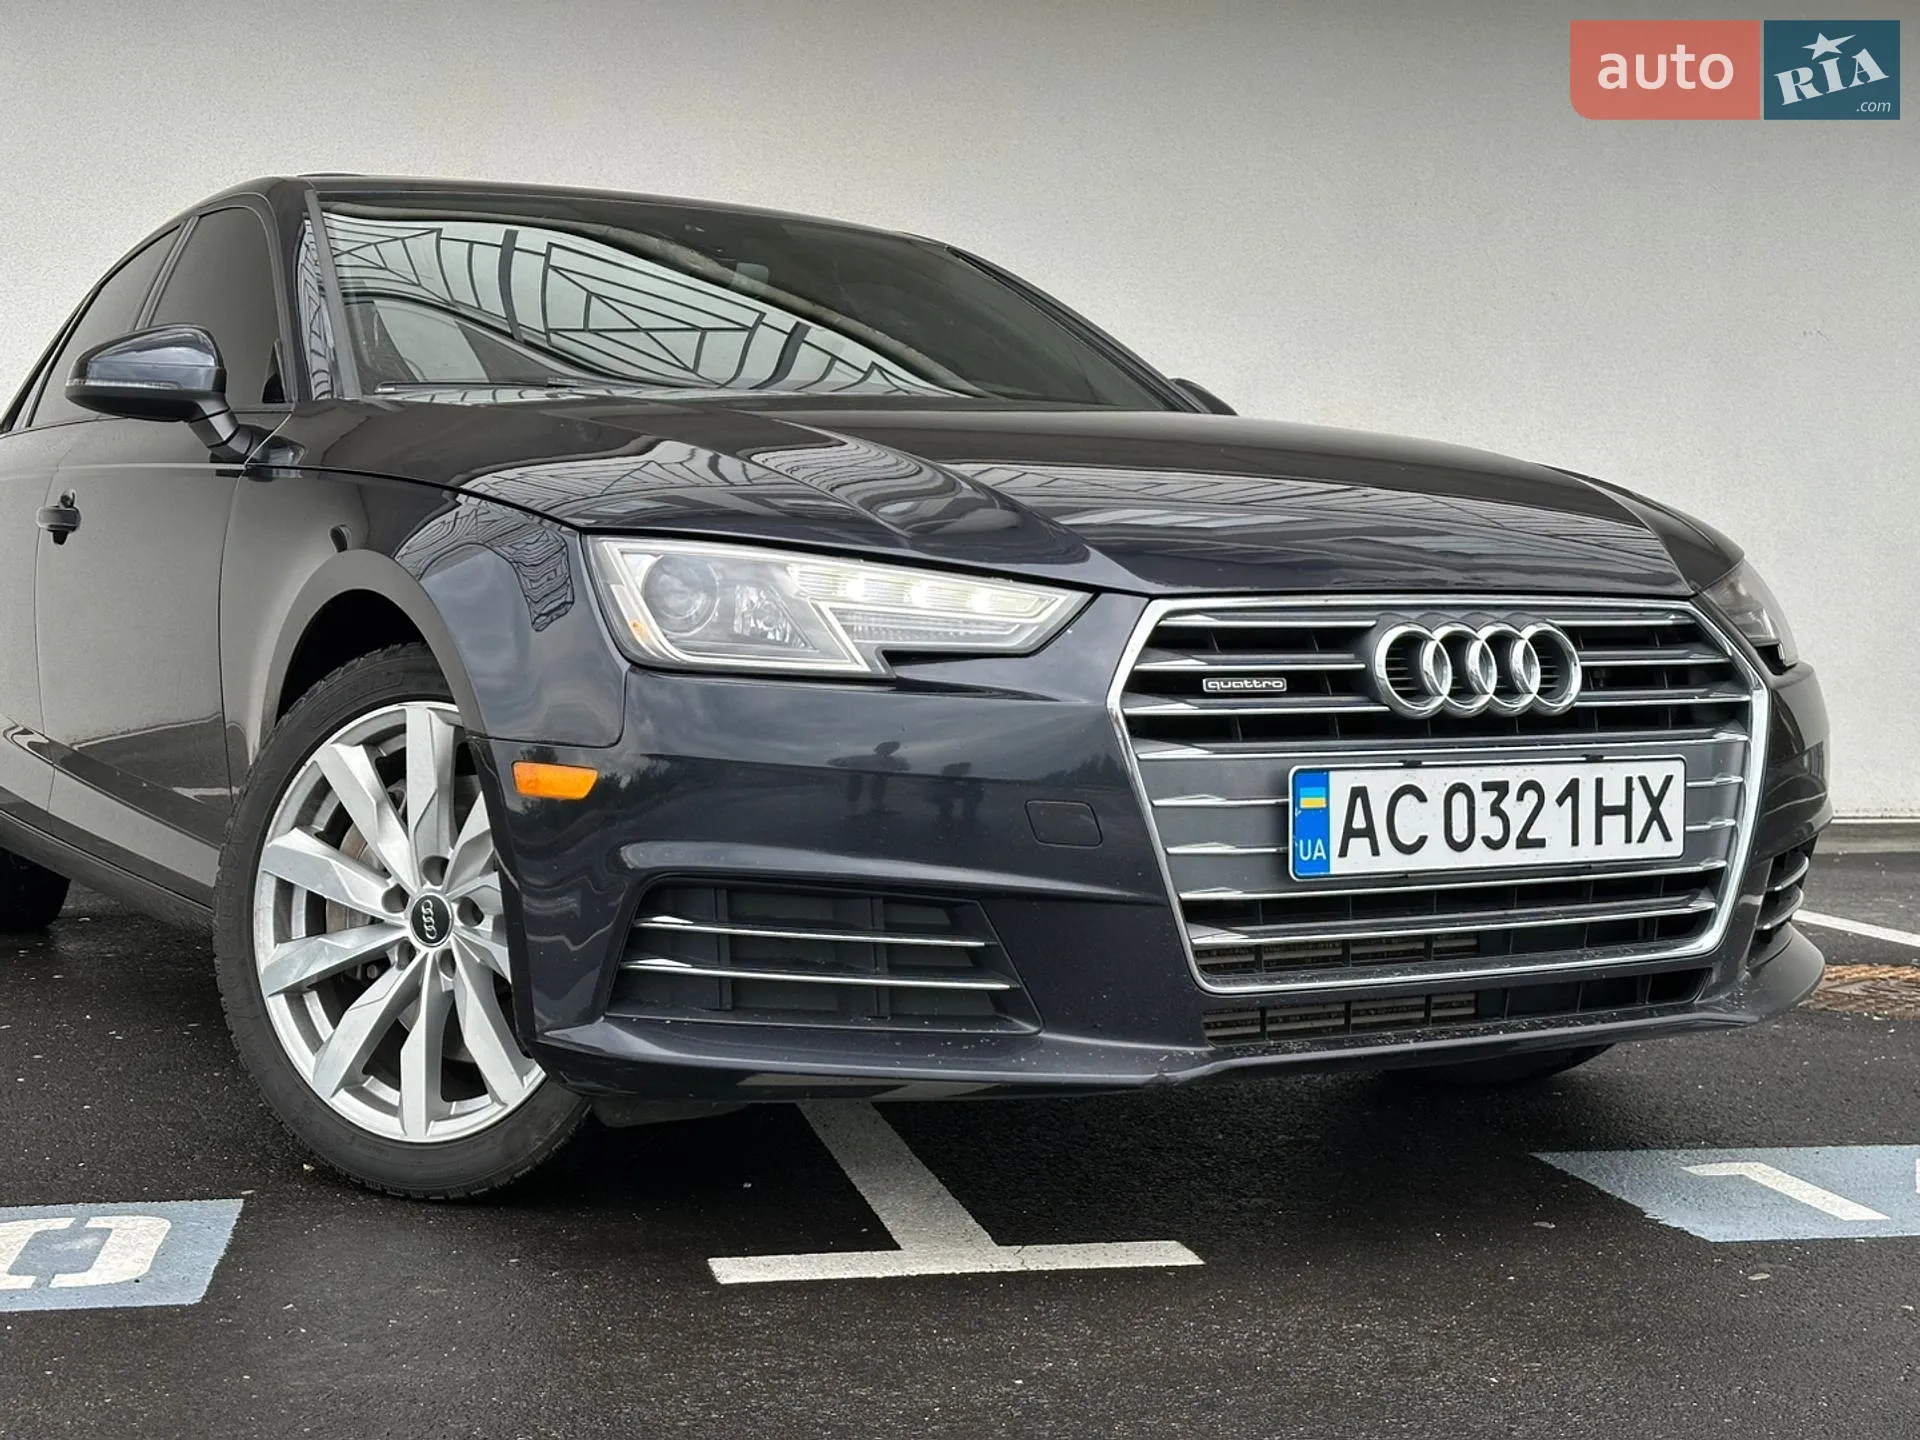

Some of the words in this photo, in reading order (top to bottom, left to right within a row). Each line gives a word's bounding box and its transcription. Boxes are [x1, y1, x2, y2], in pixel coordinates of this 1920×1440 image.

[1207, 679, 1284, 690] quattro
[1337, 783, 1429, 858] AC
[1442, 777, 1580, 853] 0321
[1594, 774, 1674, 846] HX
[1299, 838, 1327, 861] UA
